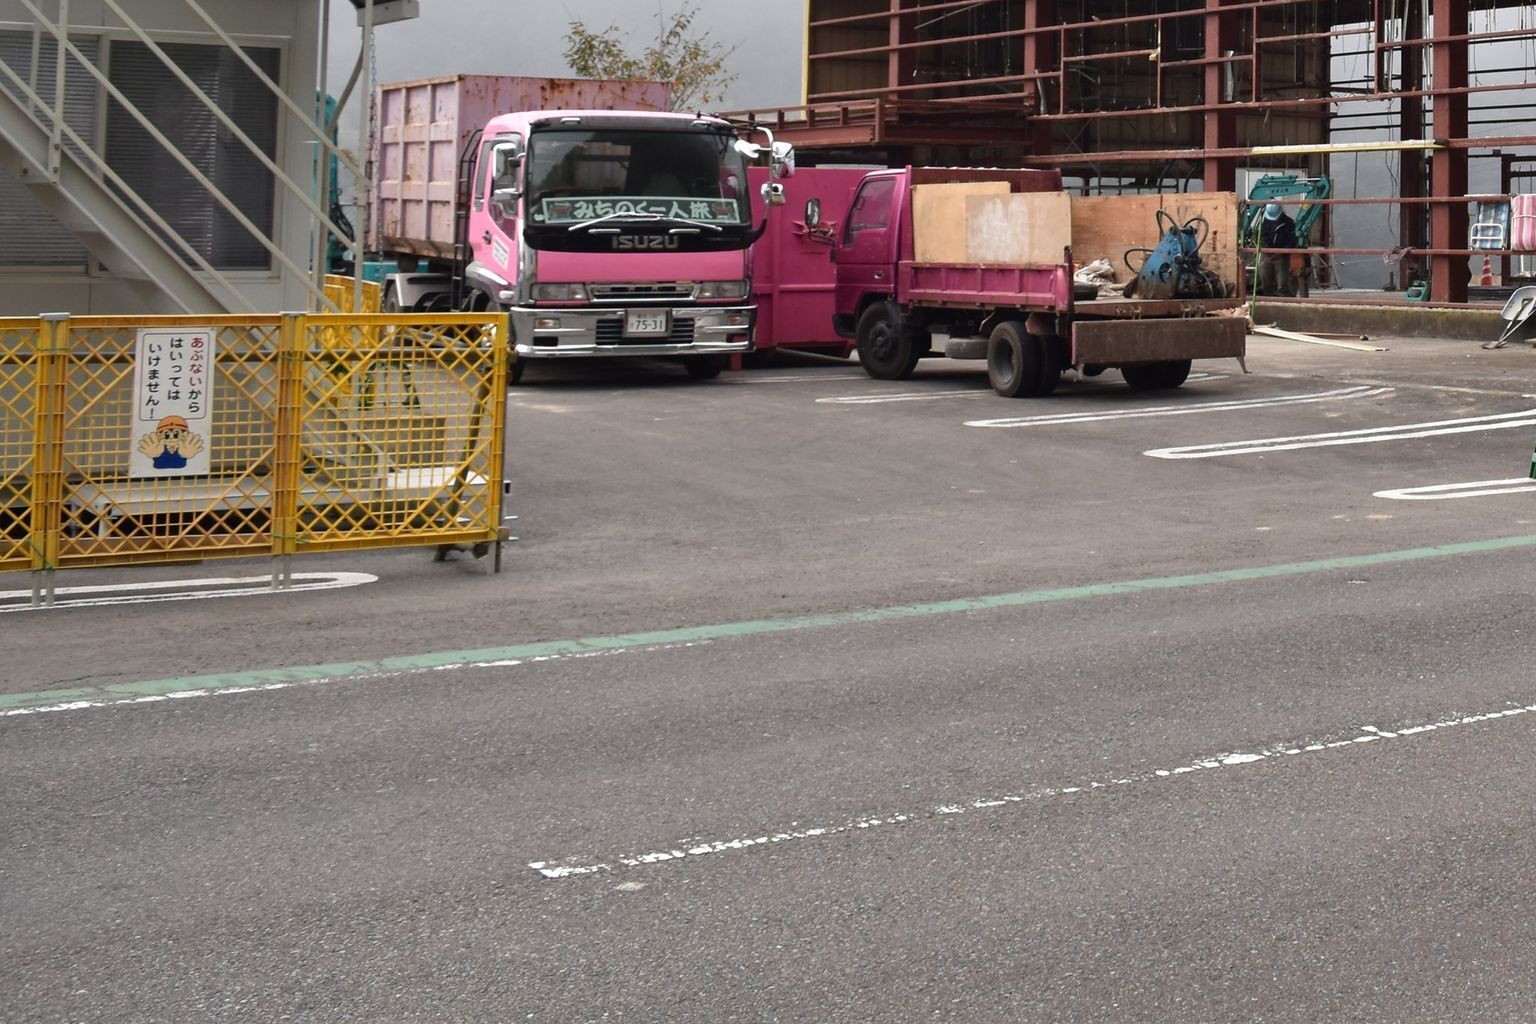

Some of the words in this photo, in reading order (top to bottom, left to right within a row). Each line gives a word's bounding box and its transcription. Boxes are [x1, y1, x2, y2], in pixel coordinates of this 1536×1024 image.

[573, 201, 713, 219] みちのく一人旅
[612, 235, 679, 249] ISUZU
[635, 319, 663, 331] 75-31
[167, 337, 184, 401] はいっては
[188, 337, 204, 413] あぶないから
